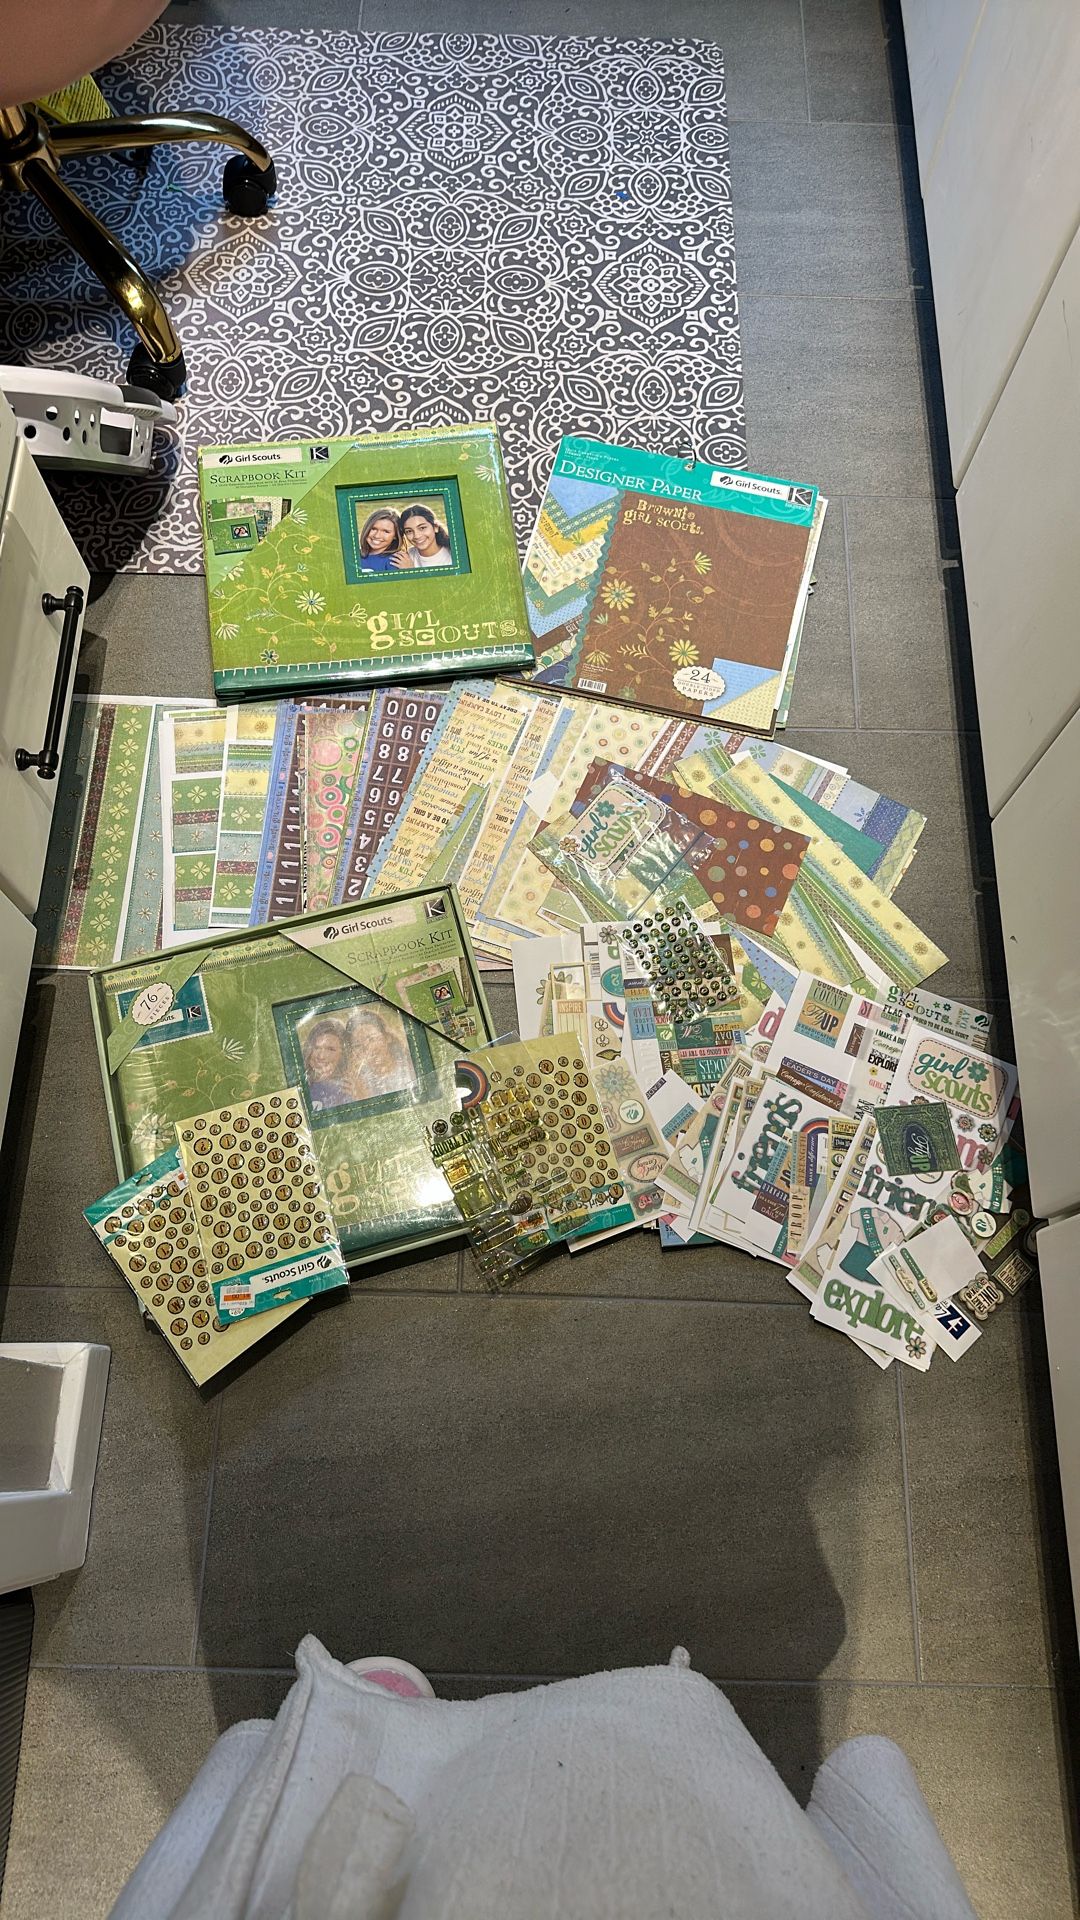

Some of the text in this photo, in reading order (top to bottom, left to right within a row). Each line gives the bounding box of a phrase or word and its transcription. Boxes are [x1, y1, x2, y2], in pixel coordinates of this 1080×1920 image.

[560, 460, 702, 501] DESIGNER PAPER
[736, 480, 750, 488] Girl
[690, 669, 711, 683] 24
[682, 687, 714, 697] PAPERS
[413, 807, 426, 818] GIRL
[432, 814, 441, 822] BE
[405, 816, 435, 831] CAMPING
[581, 812, 608, 859] girl
[342, 916, 393, 934] Girl Scouts
[140, 993, 158, 1010] 76
[560, 1002, 582, 1012] INSPIRE
[814, 989, 846, 1009] COUNT
[150, 996, 170, 1020] PIECES
[633, 1008, 651, 1017] LEAD
[883, 1004, 903, 1018] FLAG
[635, 1024, 655, 1034] LIVE
[820, 1013, 839, 1033] UP
[714, 1031, 732, 1043] DAY
[879, 1030, 893, 1040] MAKE
[944, 1026, 954, 1035] GIRL
[955, 1030, 969, 1040] SCOUT
[782, 1060, 837, 1086] LEADER'S DAY
[914, 1052, 970, 1080] girl
[921, 1070, 992, 1113] scouts
[429, 1134, 462, 1159] TROOP
[796, 1136, 808, 1185] STRENGTH
[910, 1154, 931, 1172] UP
[788, 1194, 805, 1237] TROOP
[298, 1261, 315, 1275] Girl
[976, 1284, 1000, 1308] ONE
[823, 1278, 925, 1342] explore
